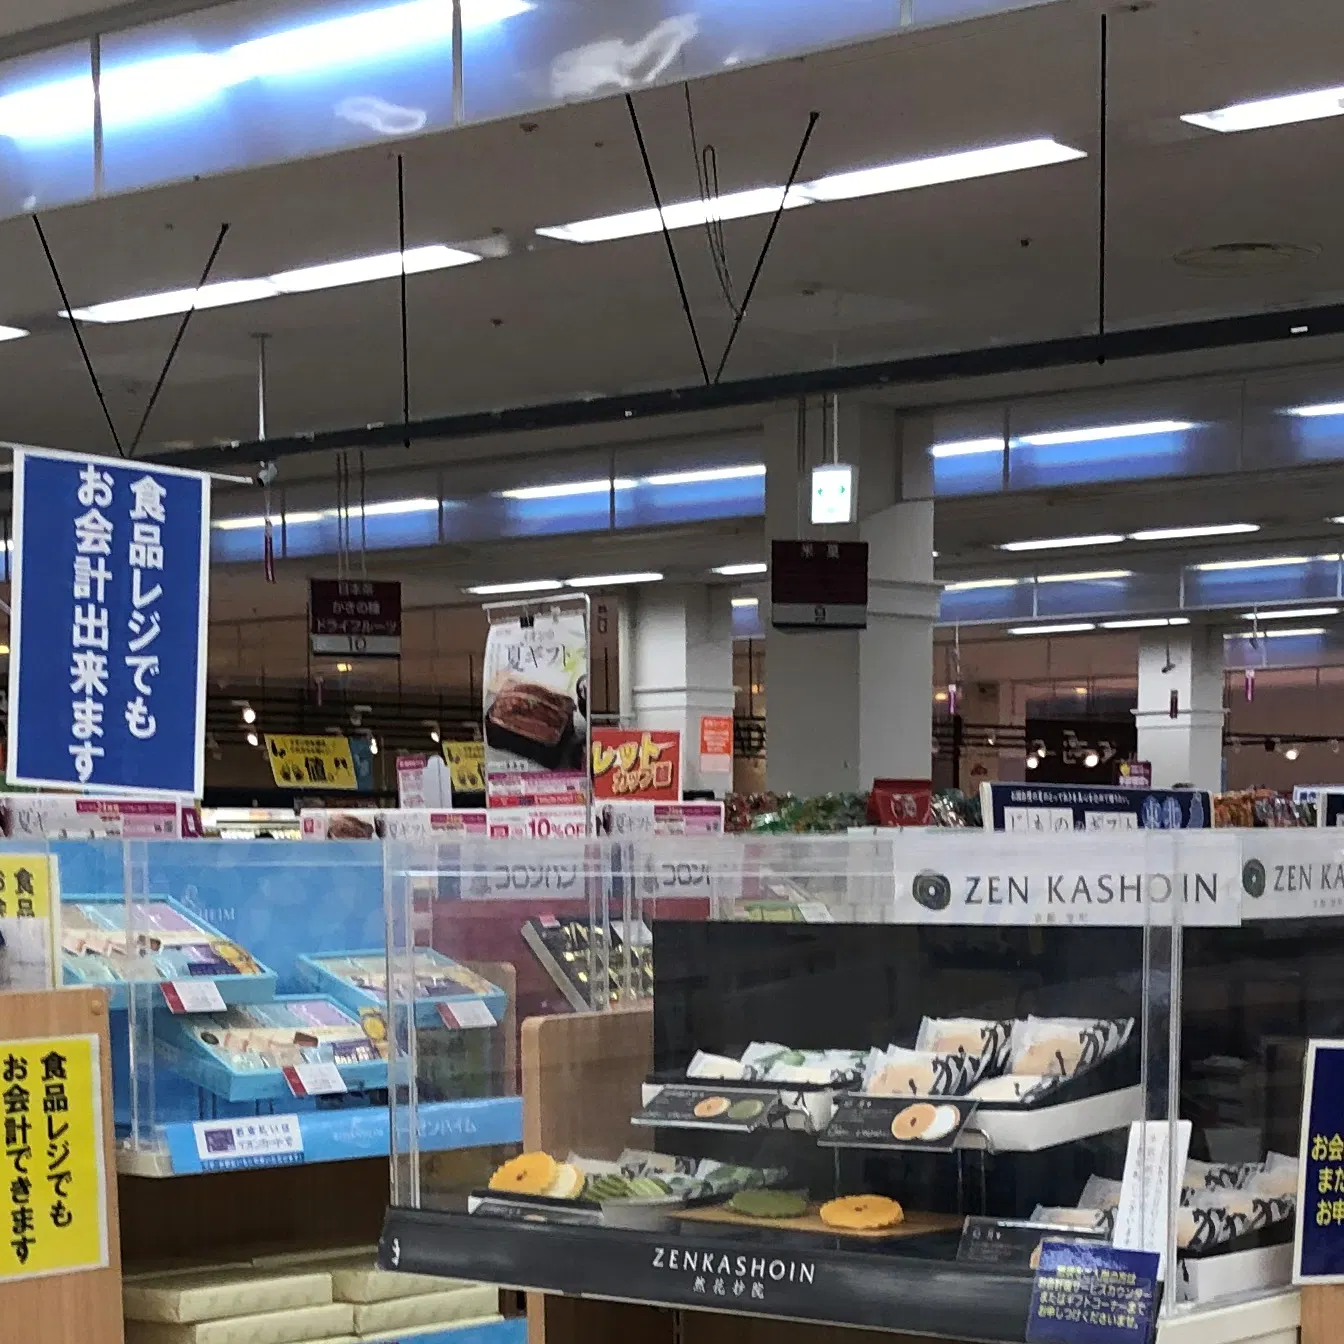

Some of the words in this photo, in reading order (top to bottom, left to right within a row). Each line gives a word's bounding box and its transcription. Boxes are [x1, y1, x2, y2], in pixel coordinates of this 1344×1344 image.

[69, 464, 115, 783] お会計出来ます
[125, 475, 167, 740] 食品レジでも
[316, 619, 397, 634] ドライフルーツ
[347, 636, 367, 651] 10
[13, 867, 35, 917] 食品
[963, 874, 1030, 906] ZEN
[1047, 873, 1219, 906] KASHOIN
[1273, 864, 1314, 892] ZEN
[2, 1052, 36, 1265] お会計できます
[40, 1050, 73, 1228] 食品レジでも
[652, 1246, 816, 1285] ZENKASHOIN
